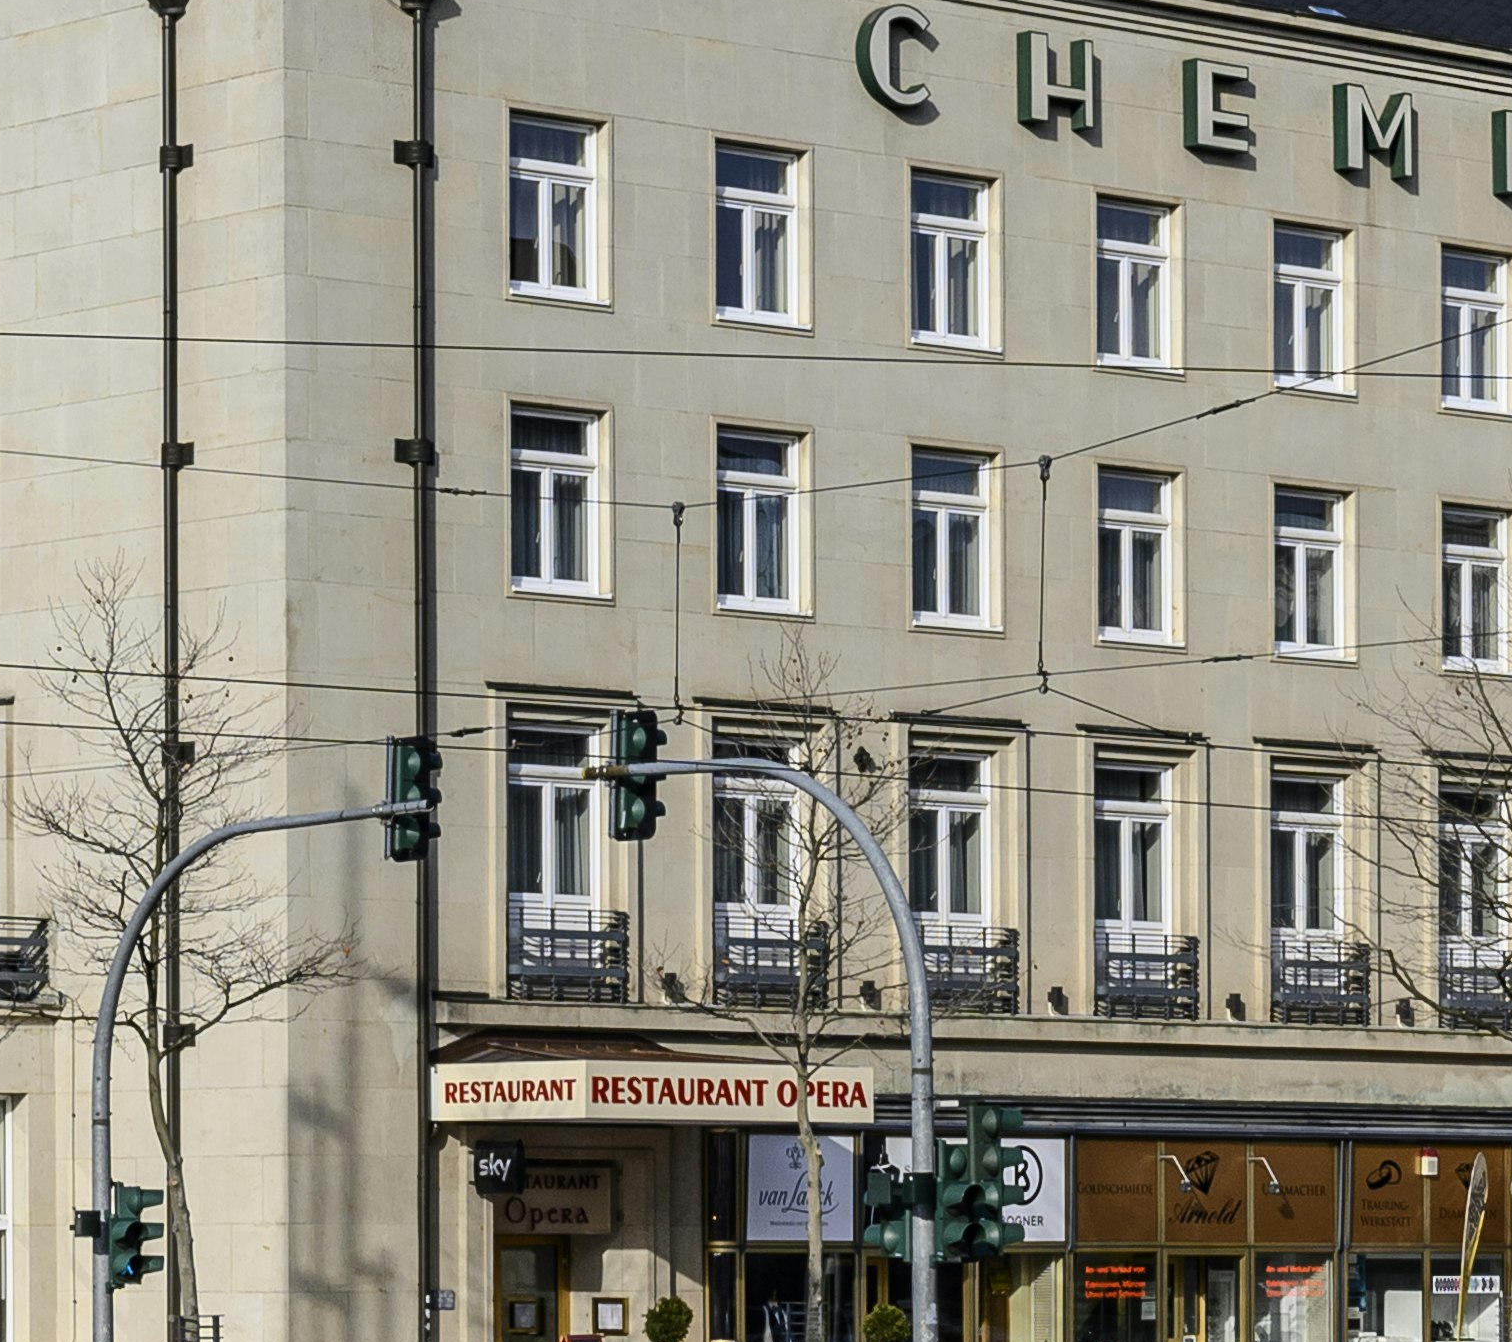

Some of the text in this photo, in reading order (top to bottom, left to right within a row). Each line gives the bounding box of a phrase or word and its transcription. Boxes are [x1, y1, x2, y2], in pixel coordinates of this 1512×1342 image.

[444, 1079, 576, 1104] RESTAURANT
[591, 1076, 769, 1106] RESTAURANT
[479, 1152, 511, 1182] sky
[526, 1174, 600, 1190] TAURANT
[1168, 1198, 1243, 1225] Arnold
